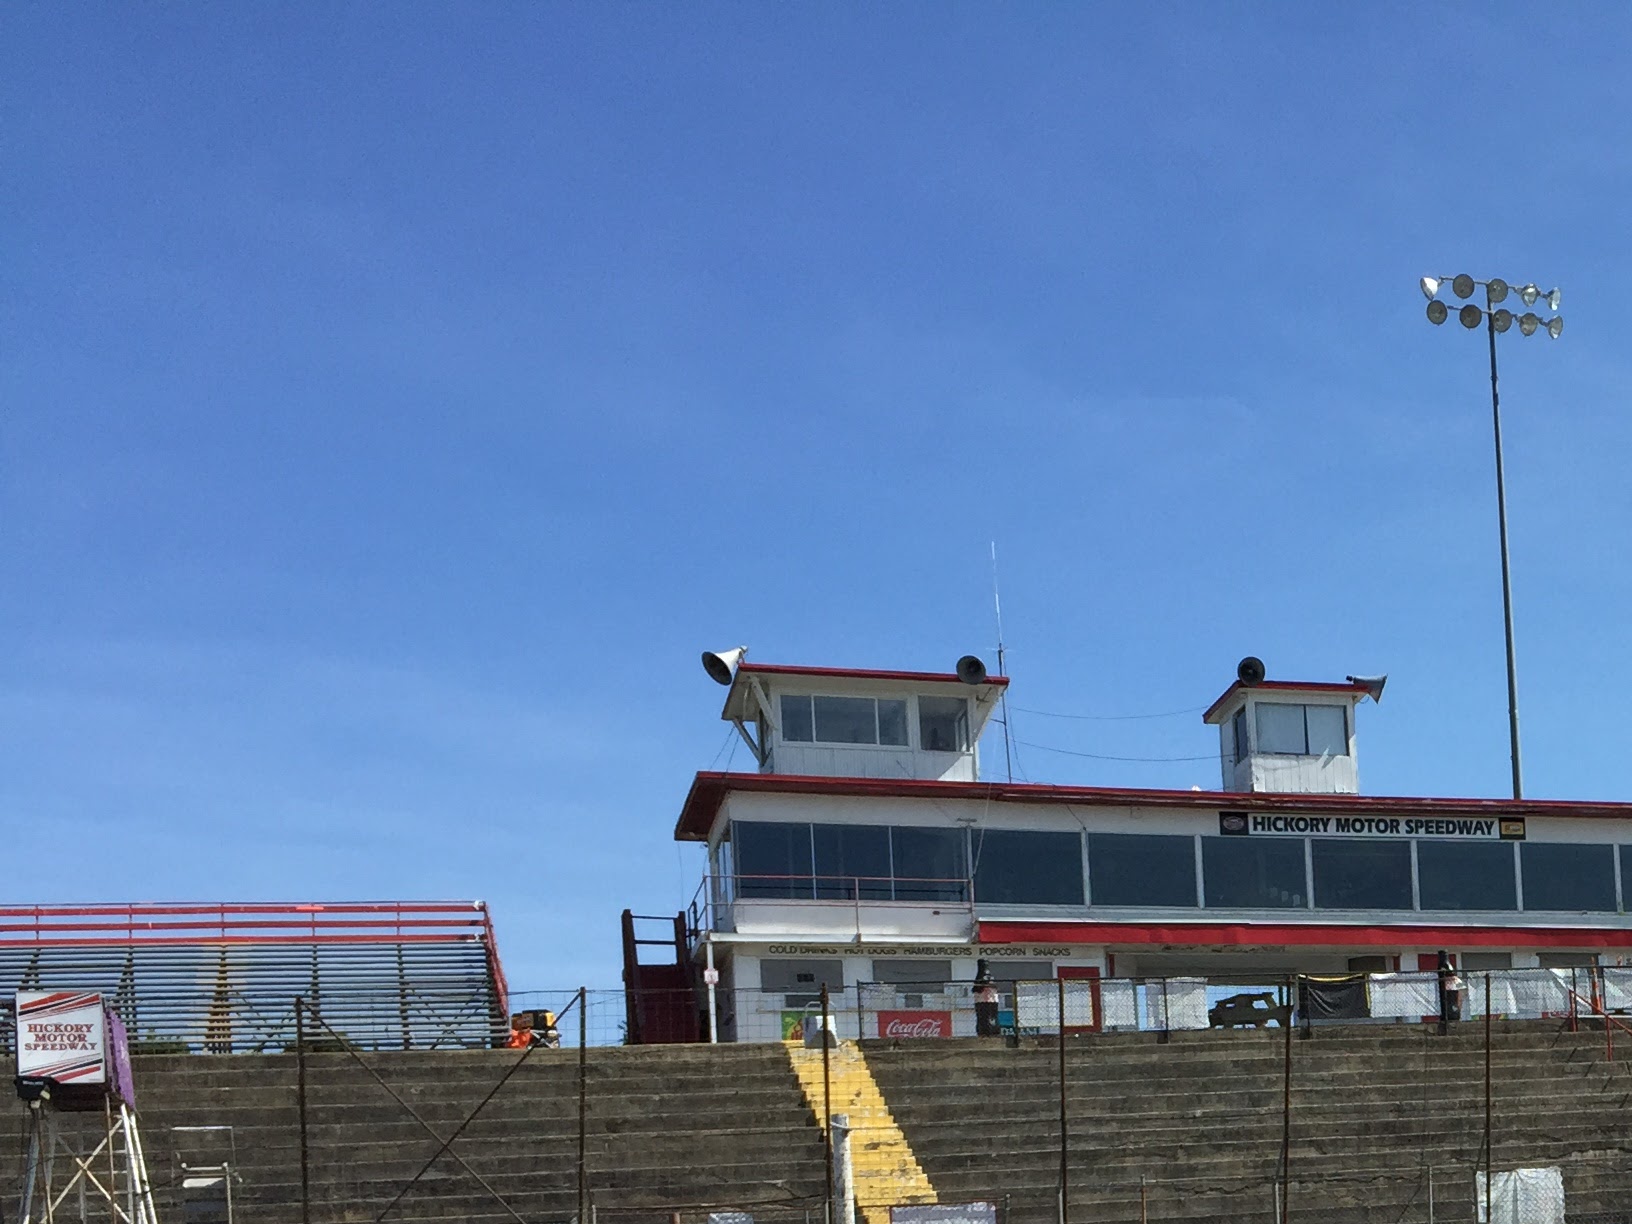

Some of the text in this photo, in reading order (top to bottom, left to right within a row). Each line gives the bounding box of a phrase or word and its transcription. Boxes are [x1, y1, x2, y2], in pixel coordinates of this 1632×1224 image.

[1253, 816, 1495, 836] HICKORY MOTOR SPEEDWAY
[768, 945, 797, 954] COLD
[903, 946, 973, 956] HAMBURGERS
[979, 947, 1026, 956] POPCORN
[1032, 947, 1071, 957] SNACKS
[27, 1023, 94, 1033] HICKORY
[34, 1033, 87, 1043] MOTOR
[24, 1042, 98, 1051] SPEEDWAY
